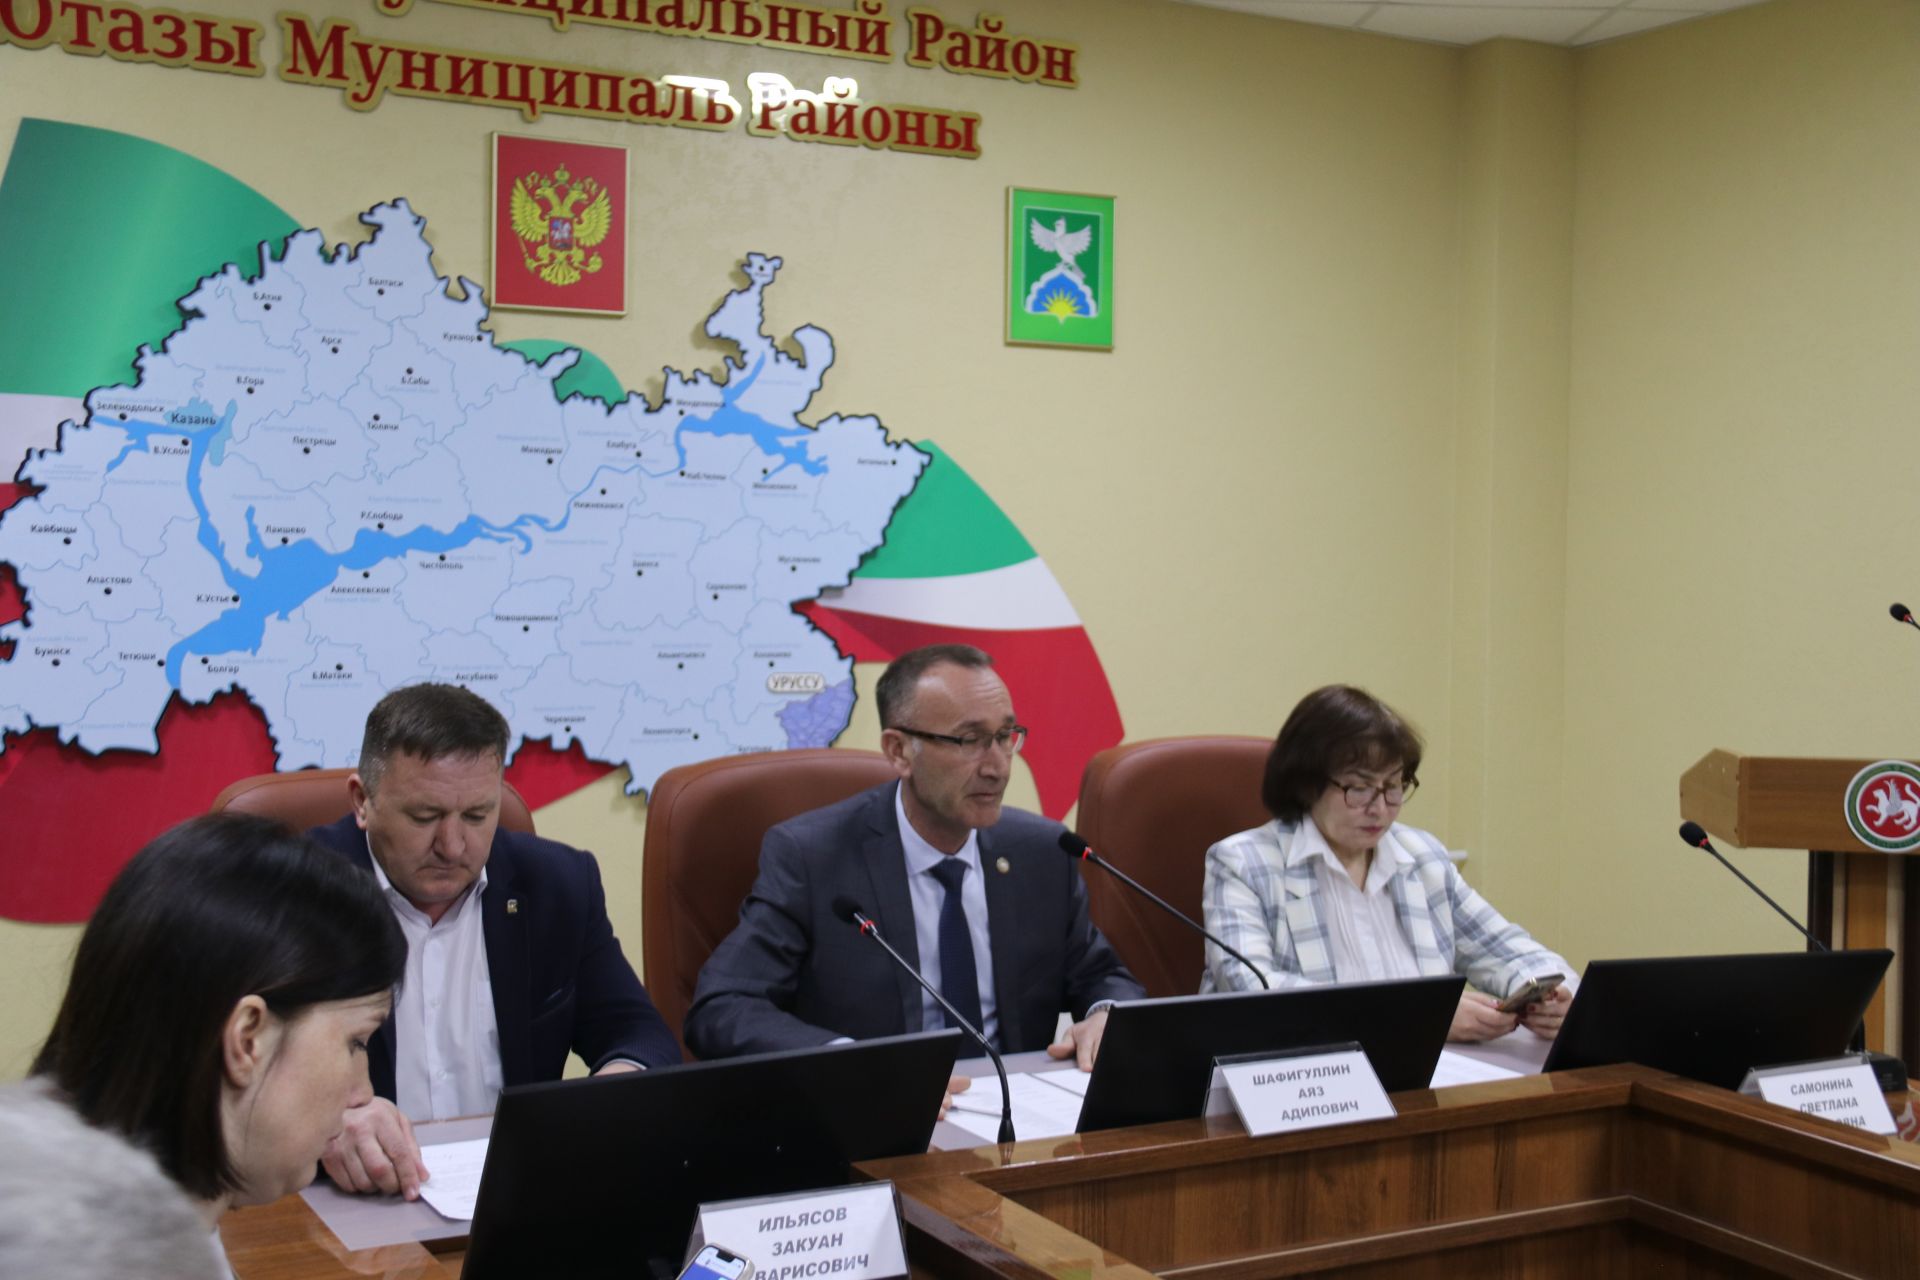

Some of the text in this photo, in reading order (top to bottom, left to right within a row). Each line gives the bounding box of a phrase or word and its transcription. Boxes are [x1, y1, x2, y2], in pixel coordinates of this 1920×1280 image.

[375, 0, 1076, 83] пальный Район
[284, 17, 735, 127] Муниципаль
[755, 82, 979, 153] Районы
[97, 401, 164, 413] Зеленодольск
[171, 413, 216, 425] Казань
[31, 525, 77, 534] Кайбицы
[34, 646, 71, 656] Буинск
[207, 664, 239, 675] Болгар
[772, 675, 820, 688] УРУССУ
[1252, 1064, 1351, 1086] ШАФИГУЛЛИН
[1298, 1086, 1325, 1099] АЯЗ
[1790, 1078, 1853, 1095] САМОНИНА
[1281, 1100, 1359, 1121] АДИПОВИЧ
[1800, 1097, 1859, 1113] СВЕТЛАНА
[758, 1207, 848, 1233] ИЛЬЯСОВ
[772, 1233, 844, 1256] ЗАКУАН
[755, 1254, 869, 1280] ВАРИСОВИЧ
